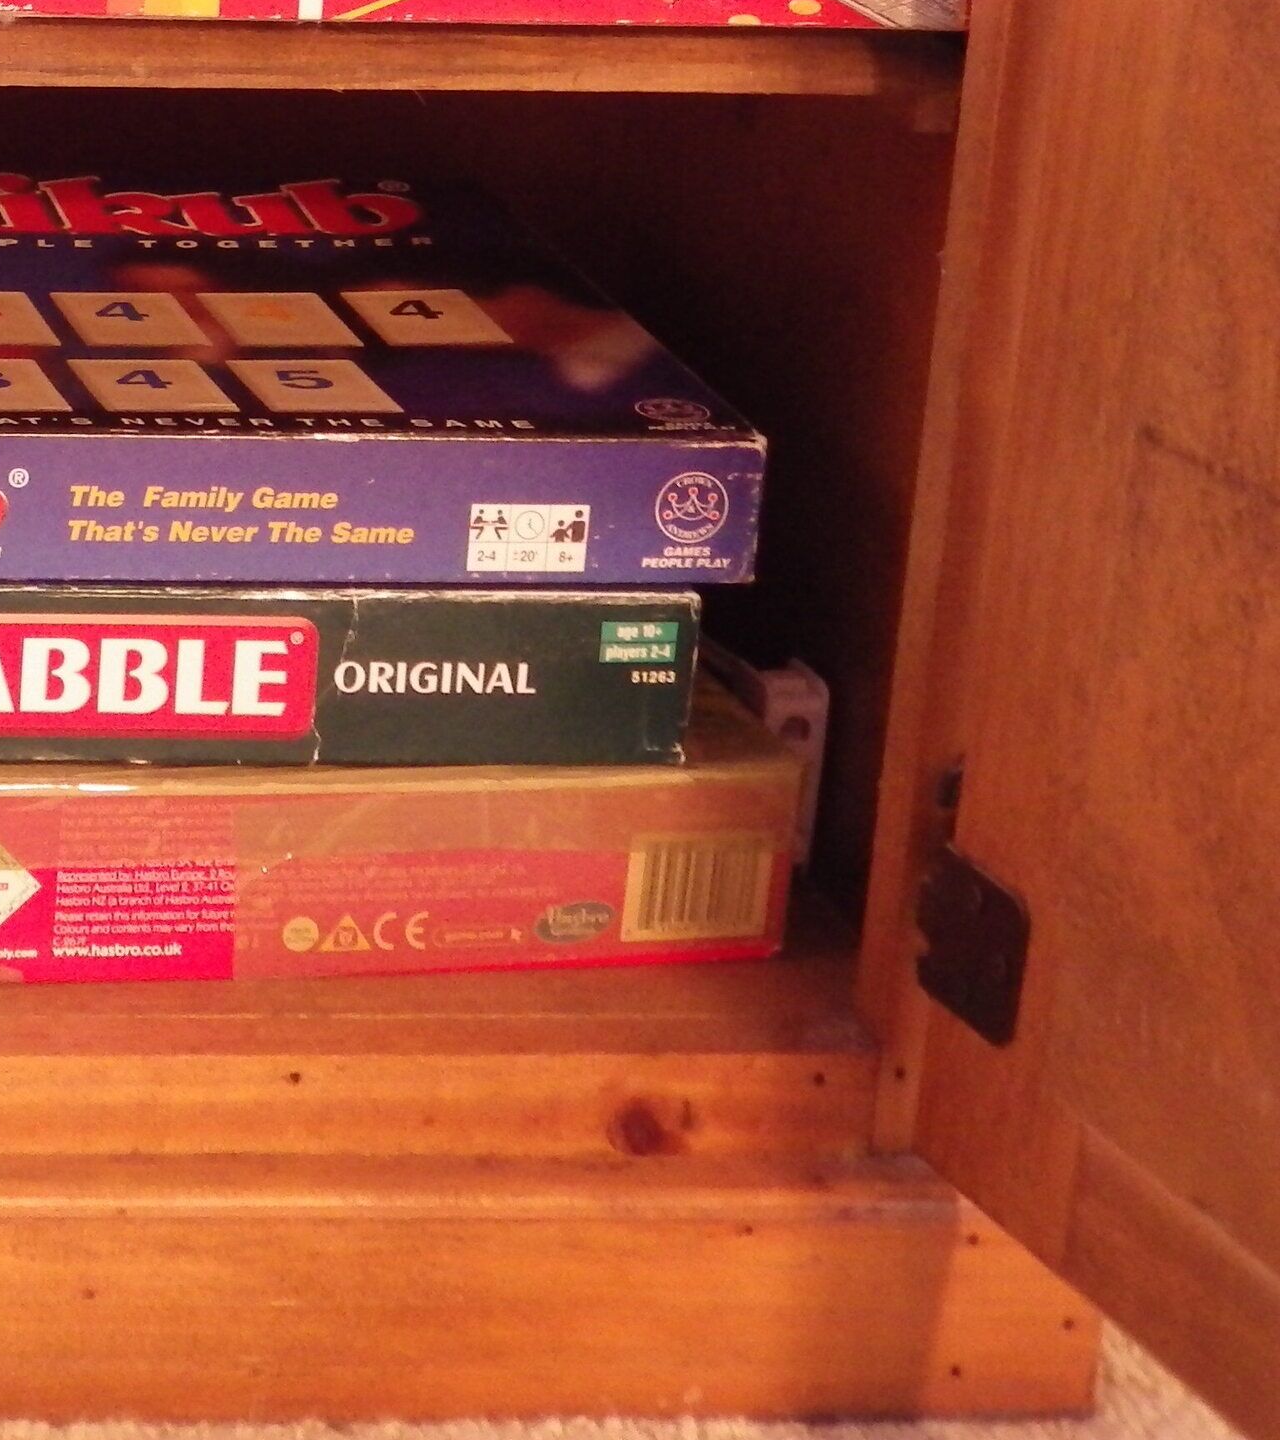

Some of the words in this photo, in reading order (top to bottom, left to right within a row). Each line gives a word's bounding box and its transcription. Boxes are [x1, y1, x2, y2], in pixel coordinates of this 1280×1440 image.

[138, 235, 435, 249] TOGETHER
[93, 300, 149, 322] 4
[388, 298, 445, 321] 4
[114, 368, 173, 390] 4
[276, 368, 334, 391] 5
[121, 416, 274, 429] NEVER
[295, 418, 387, 430] THE
[409, 419, 538, 431] SAME
[70, 485, 125, 509] The
[143, 485, 243, 514] Family
[251, 486, 339, 510] Game
[68, 520, 162, 545] That's
[168, 521, 262, 544] Never
[269, 521, 323, 544] The
[328, 523, 415, 546] Same
[663, 546, 711, 558] GAMES
[641, 557, 692, 569] PEOPLE
[695, 558, 732, 569] PLAY
[617, 626, 639, 640] age
[605, 645, 648, 661] players
[650, 644, 671, 658] 2-4
[334, 661, 536, 695] ORIGINAL
[631, 670, 676, 684] 51263
[52, 944, 183, 958] www.hasbro.co.uk
